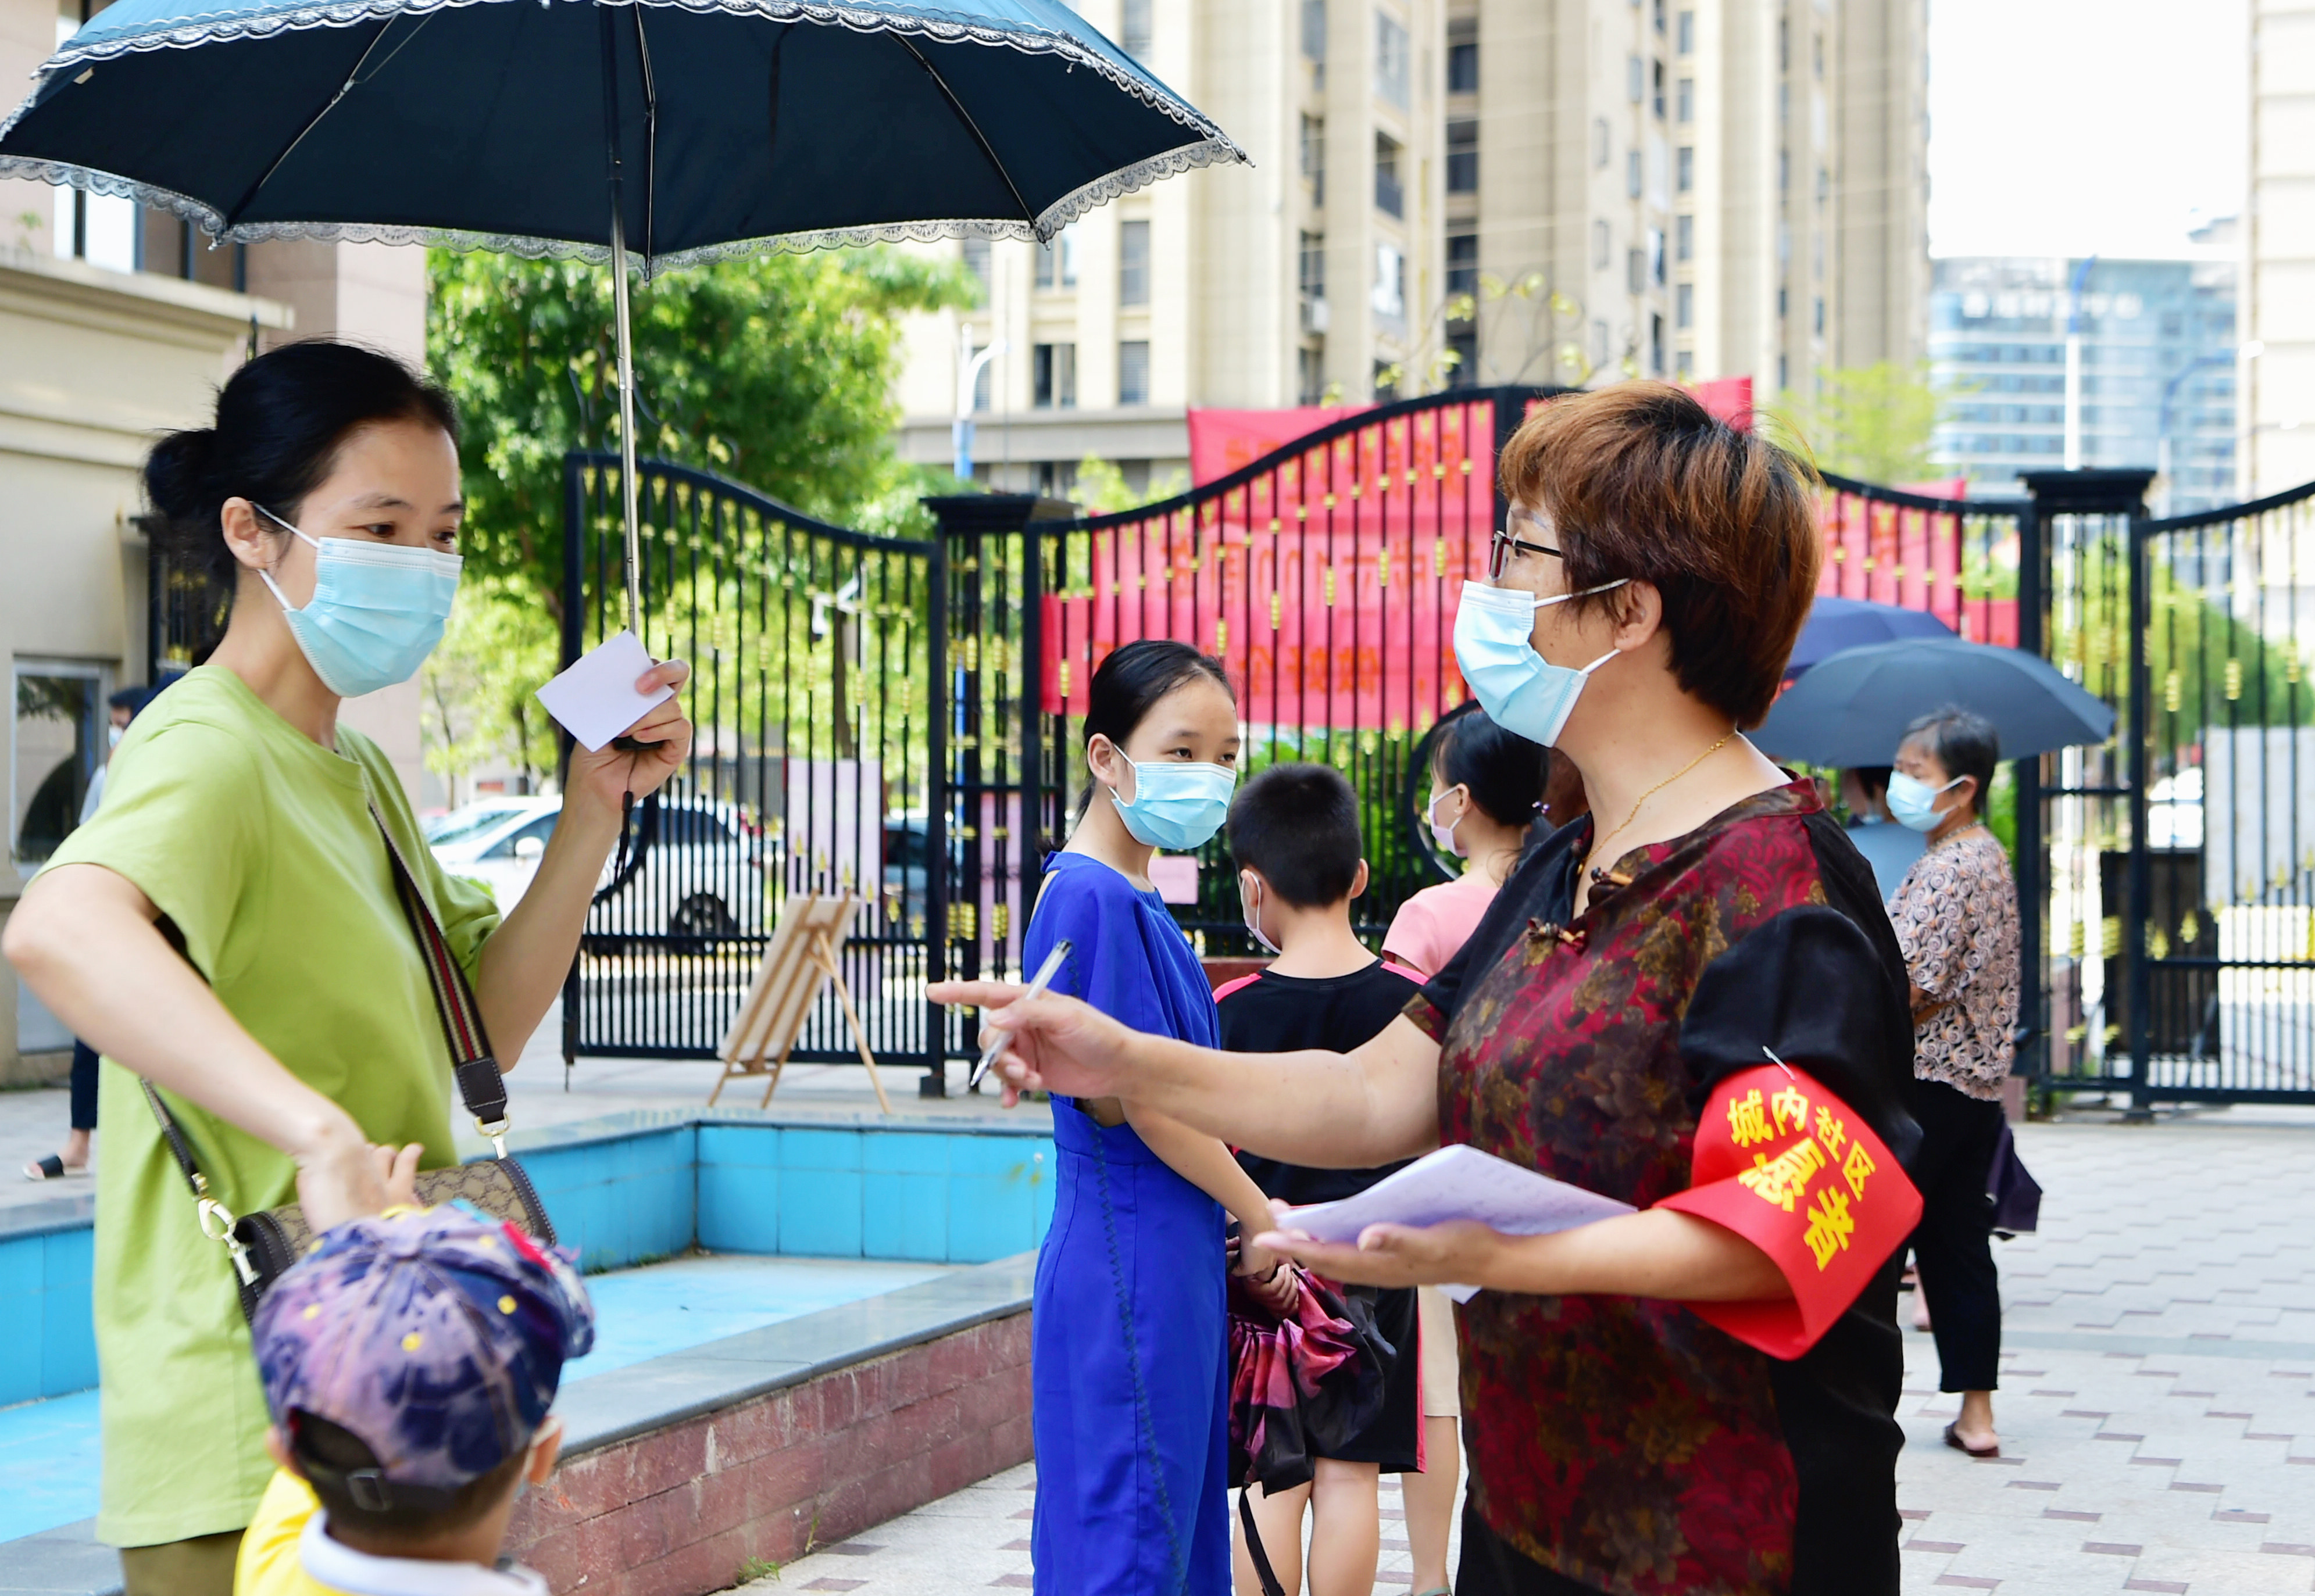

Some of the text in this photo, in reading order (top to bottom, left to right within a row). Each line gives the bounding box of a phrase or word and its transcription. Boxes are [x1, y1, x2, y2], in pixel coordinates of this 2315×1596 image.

[1727, 1085, 1876, 1201] 城内社区
[1738, 1137, 1855, 1272] 愿者
